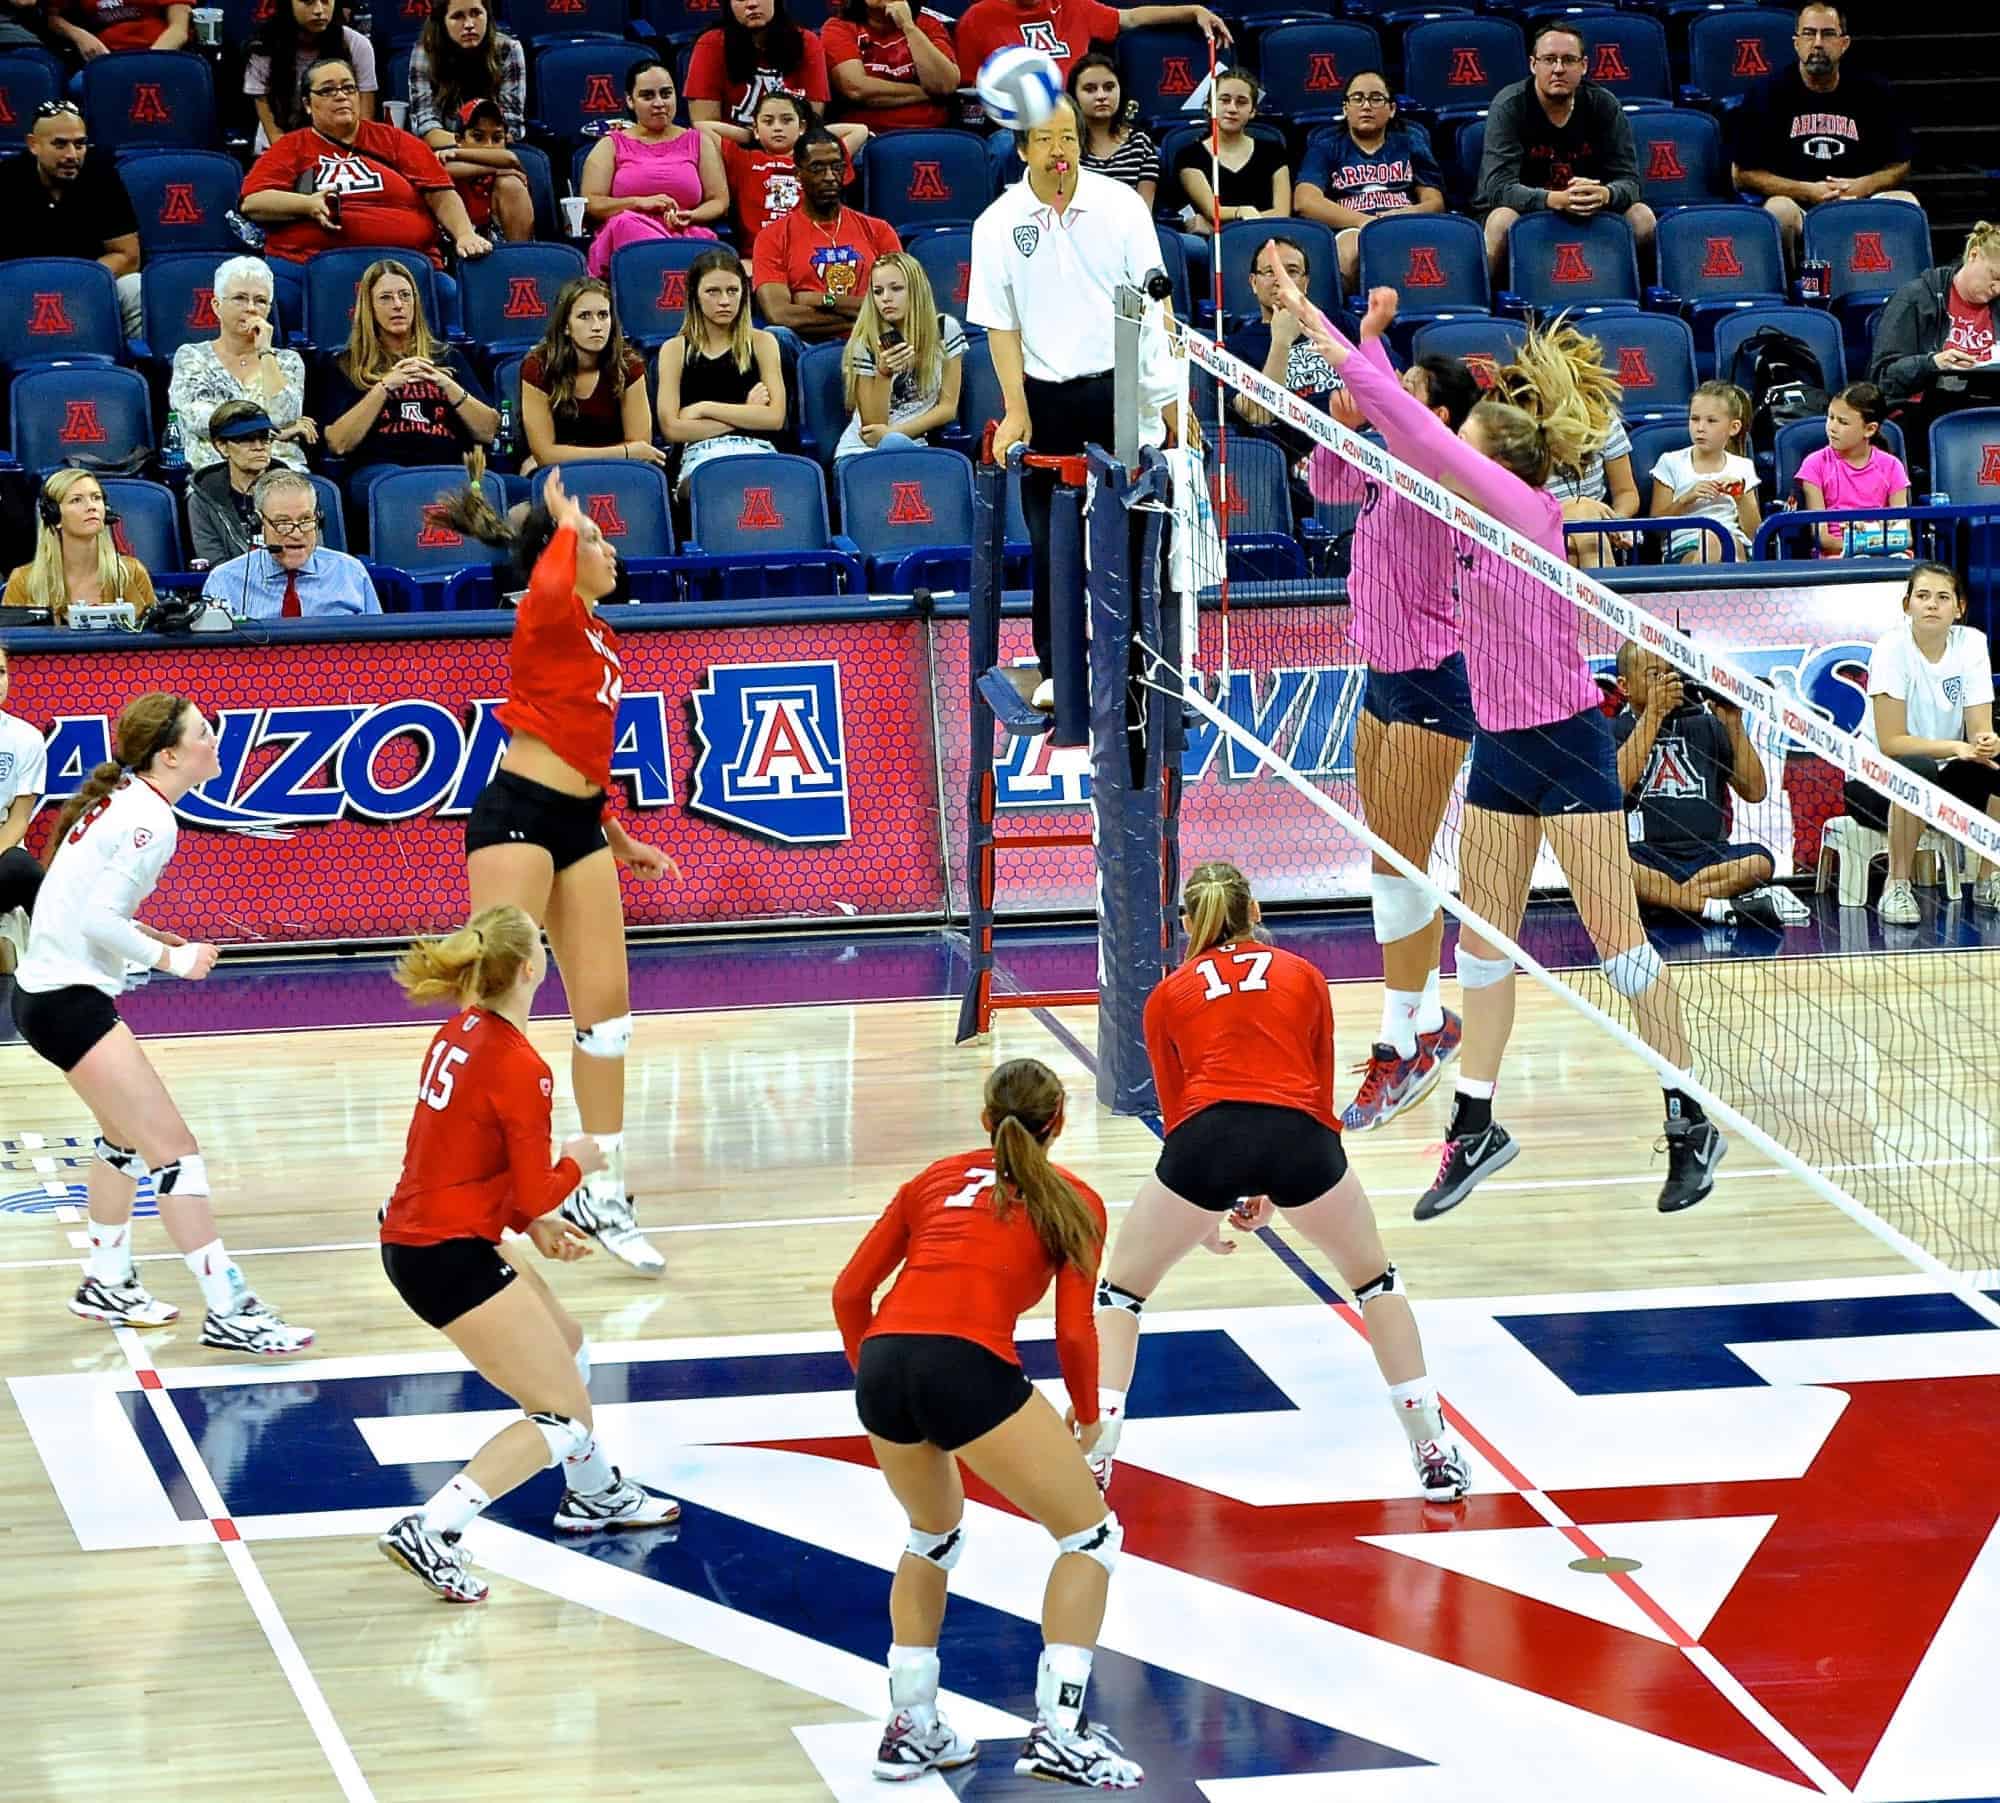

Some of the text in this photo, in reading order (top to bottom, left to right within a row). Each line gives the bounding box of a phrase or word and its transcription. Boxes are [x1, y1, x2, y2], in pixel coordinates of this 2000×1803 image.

[1019, 21, 1070, 58] A
[1734, 39, 1770, 77] A
[1159, 58, 1197, 96] A
[1306, 54, 1343, 91] A
[1449, 49, 1487, 85] A
[1593, 43, 1630, 80] A
[130, 85, 169, 123] A
[582, 76, 621, 114] A
[1790, 113, 1859, 141] ARIZONA
[315, 153, 384, 195] A
[909, 162, 950, 201] A
[1331, 159, 1413, 190] ARIZONA
[1646, 143, 1685, 181] A
[160, 184, 203, 224] A
[1405, 248, 1445, 288] A
[1553, 244, 1592, 284] A
[1702, 239, 1743, 277] A
[1851, 233, 1892, 272] A
[505, 278, 548, 319] A
[656, 271, 692, 312] A
[30, 294, 73, 335] A
[1614, 348, 1655, 388] A
[60, 401, 106, 444] A
[587, 494, 627, 537] A
[738, 489, 783, 530] A
[889, 482, 932, 524] A
[32, 690, 675, 826] AIZOA
[722, 684, 843, 801] A
[1639, 737, 1706, 800] A
[1196, 951, 1273, 1001] 17
[419, 1039, 470, 1111] 15
